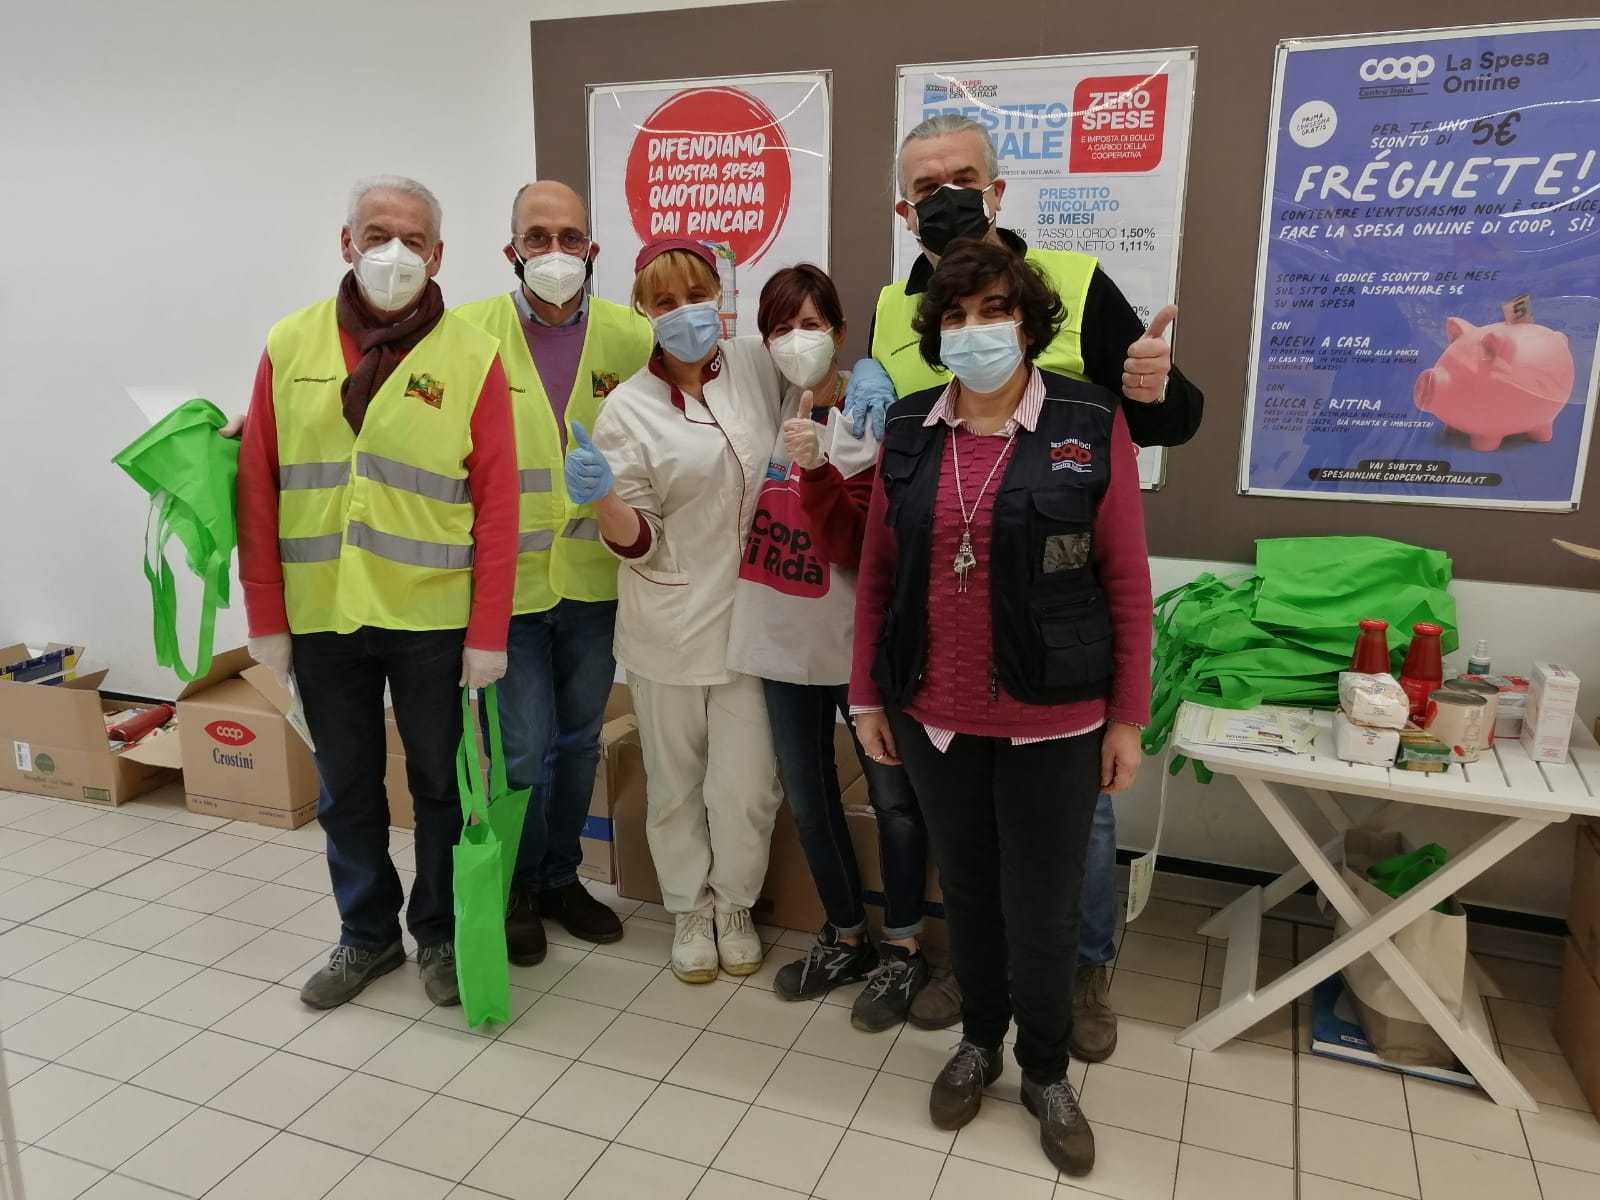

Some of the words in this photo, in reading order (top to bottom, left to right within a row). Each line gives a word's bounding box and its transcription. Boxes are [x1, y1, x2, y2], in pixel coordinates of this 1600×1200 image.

[1359, 54, 1436, 84] coop
[1445, 54, 1472, 72] La
[1480, 51, 1549, 72] Spesa
[1088, 90, 1150, 110] ZERO
[1082, 110, 1155, 130] SPESE
[1371, 123, 1400, 136] PER
[1410, 120, 1433, 134] TE
[1471, 111, 1522, 146] 5€
[1087, 135, 1119, 143] IMPOSTA
[1120, 134, 1128, 142] DI
[1129, 134, 1155, 142] BOLLO
[1123, 142, 1147, 150] DELLA
[1370, 133, 1430, 149] SCONTO
[1435, 133, 1453, 146] DI
[648, 133, 766, 162] DIFENDIAMO
[1091, 151, 1142, 160] COOPERATIVA
[648, 164, 664, 183] LA
[668, 163, 718, 182] VOSTRA
[722, 161, 765, 181] SPESA
[1294, 150, 1596, 202] FRÉGHETE!
[649, 182, 765, 209] QUOTIDIANA
[1039, 187, 1111, 200] PRESTITO
[1038, 200, 1120, 212] VINCOLATO
[1280, 207, 1360, 221] CONTENERE
[1365, 203, 1467, 219] L'ENTUSIASMO
[1474, 202, 1506, 215] NON
[650, 211, 681, 236] DAI
[687, 209, 765, 236] RINCARI
[1037, 213, 1055, 225] 36
[1059, 213, 1095, 225] MESI
[1037, 228, 1074, 239] TASSO
[1076, 227, 1117, 238] LORDO
[1120, 227, 1156, 240] 1,50%
[1279, 225, 1319, 240] FARE
[1325, 224, 1345, 238] LA
[1353, 223, 1404, 238] SPESA
[1412, 221, 1475, 237] ONLINE
[1481, 220, 1501, 234] DI
[1508, 219, 1556, 237] COOP,
[1036, 240, 1073, 251] TASSO
[1076, 240, 1115, 251] NETTO
[1119, 240, 1155, 252] 1,11%
[1276, 273, 1315, 283] SCOPRI
[1320, 273, 1330, 282] IL
[1335, 272, 1377, 283] CODICE
[1381, 271, 1430, 282] SCONTO
[1434, 271, 1458, 281] DEL
[1464, 270, 1501, 281] MESE
[1300, 286, 1328, 296] SITO
[1332, 286, 1356, 295] PER
[1361, 285, 1445, 296] RISPARMIARE
[1292, 299, 1314, 308] UNA
[1319, 299, 1356, 308] SPESA
[1271, 321, 1291, 330] CON
[1270, 335, 1315, 347] RICEVI
[1321, 336, 1331, 347] A
[1337, 336, 1371, 348] CASA
[1264, 398, 1306, 409] CLICCA
[1328, 399, 1382, 411] RITIRA
[1369, 461, 1383, 470] VAI
[1388, 463, 1423, 472] SUBITO
[1426, 464, 1440, 472] SU
[216, 725, 244, 741] coop
[212, 747, 255, 770] Crostini
